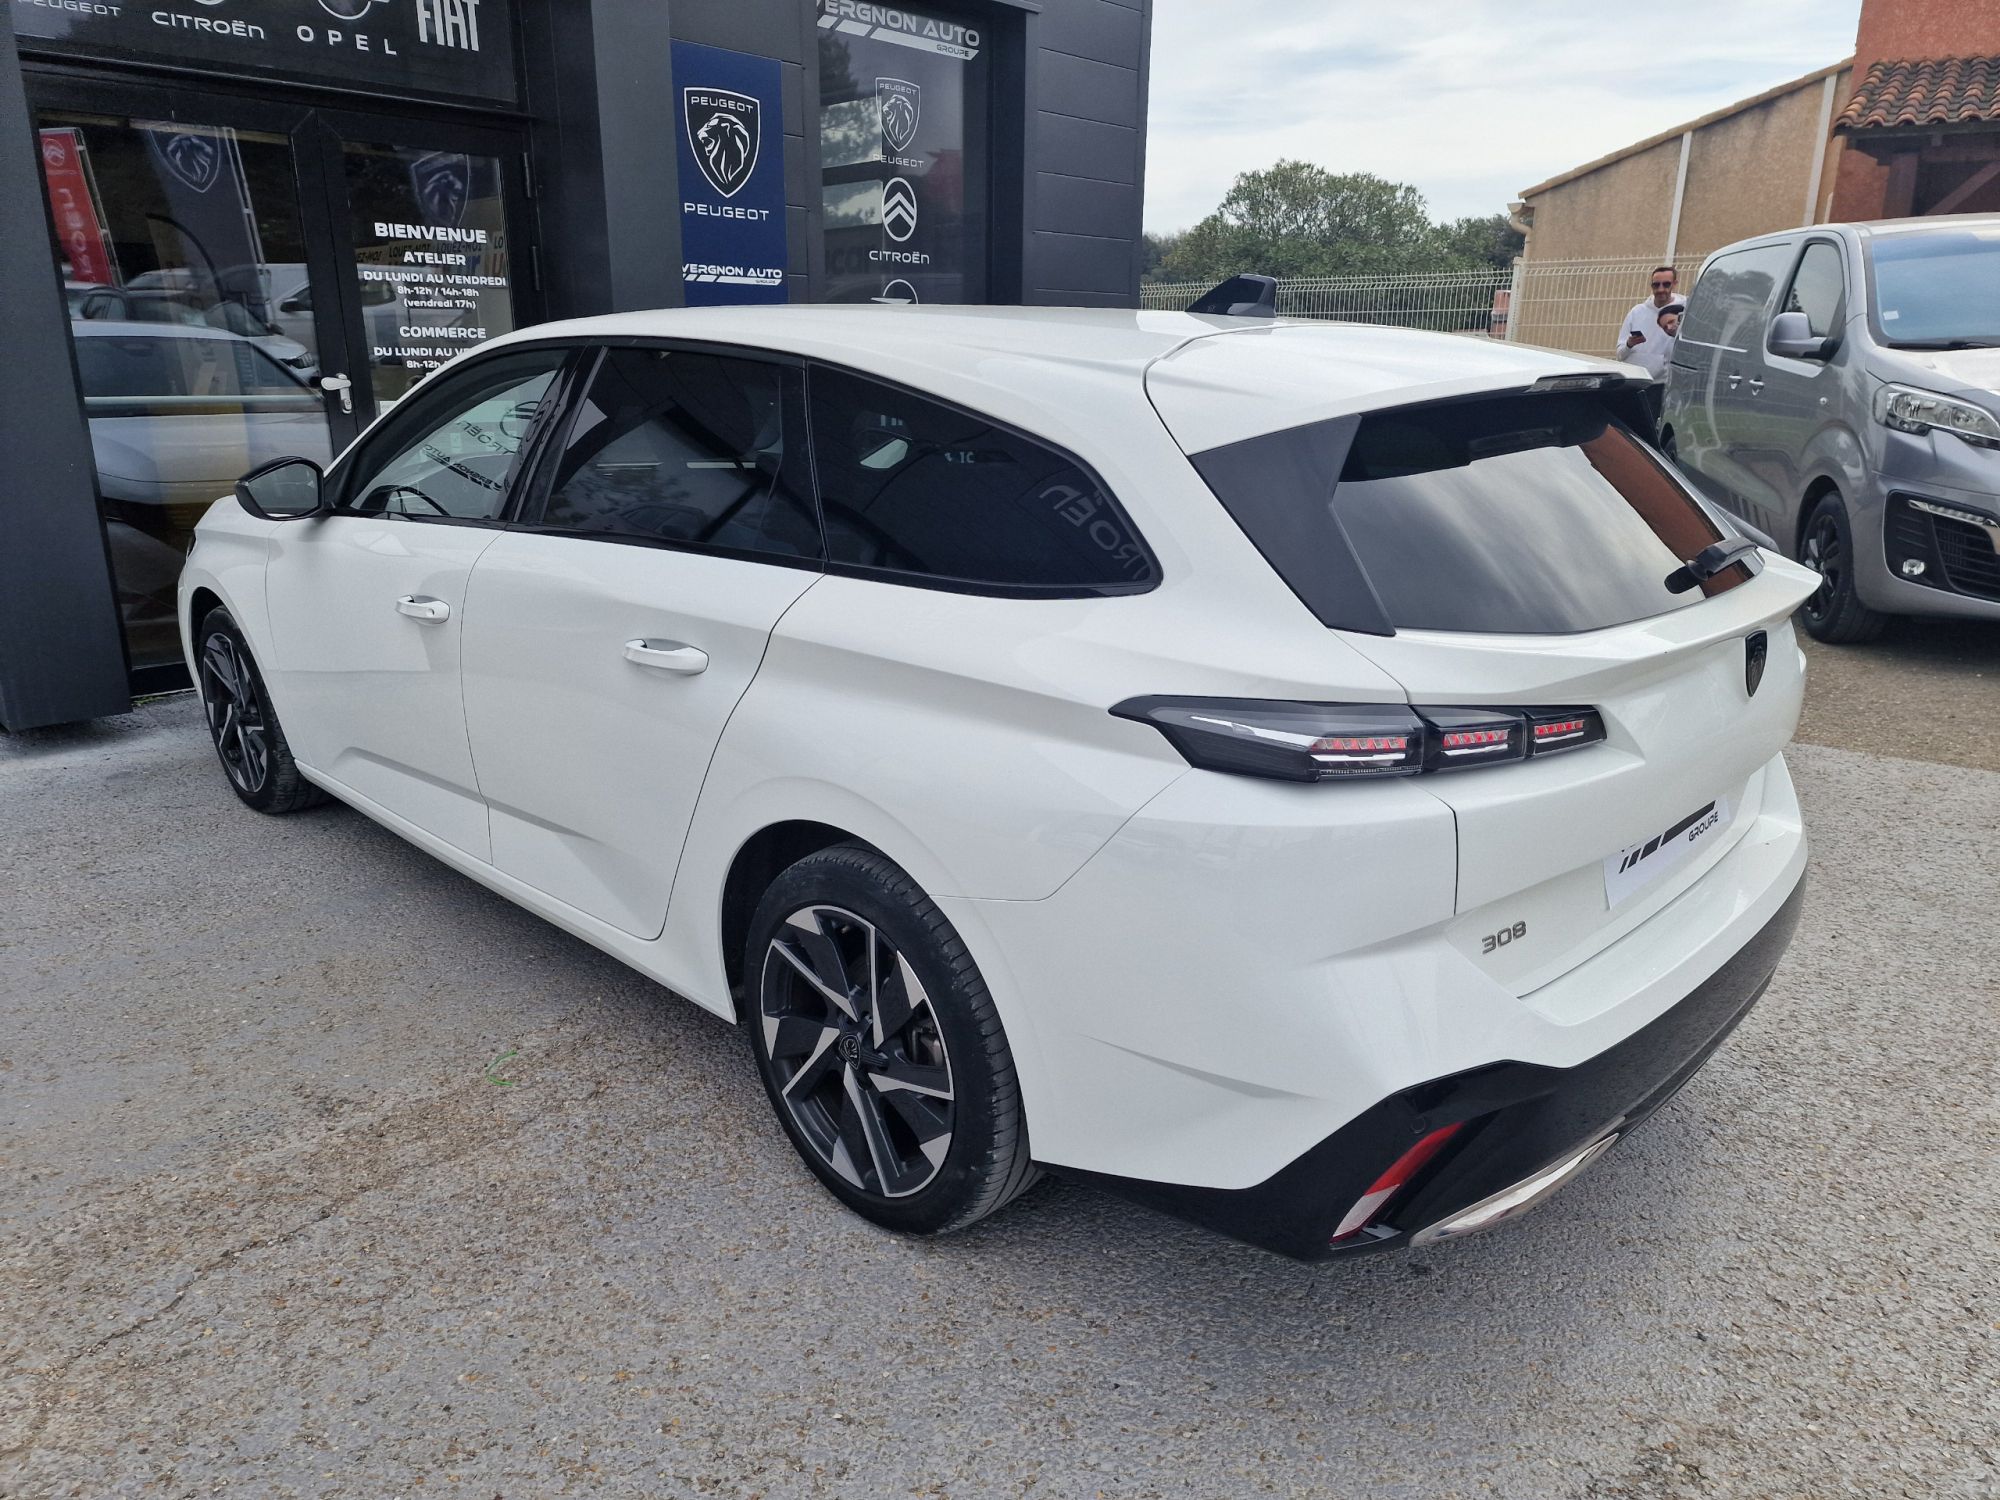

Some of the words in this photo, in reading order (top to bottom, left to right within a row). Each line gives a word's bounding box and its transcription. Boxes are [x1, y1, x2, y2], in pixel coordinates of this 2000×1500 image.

[17, 0, 121, 17] EUGEOT
[416, 0, 479, 52] FIAT
[817, 0, 917, 33] ERGNON
[922, 20, 980, 47] AUTO
[296, 25, 397, 56] OPEL
[936, 44, 970, 58] GROUPE
[879, 83, 918, 96] PEUGEOT
[690, 96, 754, 115] PEUGEOT
[872, 153, 925, 168] PEUGEOT
[684, 202, 770, 221] PEUGEOT
[374, 222, 487, 244] BIENVENUE
[403, 251, 466, 266] ATELIER
[363, 270, 383, 281] DU
[385, 271, 424, 283] LUNDI
[426, 272, 444, 284] AU
[447, 274, 507, 287] VENDREDI
[747, 267, 783, 279] AUTO
[397, 286, 433, 296] 8h-12h
[440, 287, 480, 297] 14h-18h
[403, 299, 453, 309] (vendredi
[455, 300, 477, 310] 17h)
[399, 326, 487, 339] COMMERCE
[373, 346, 393, 357] DU
[395, 347, 433, 357] LUNDI
[435, 347, 453, 357] AU
[406, 360, 442, 369] 8h-12h
[1687, 811, 1719, 842] GROUPE
[1481, 920, 1527, 955] 308
